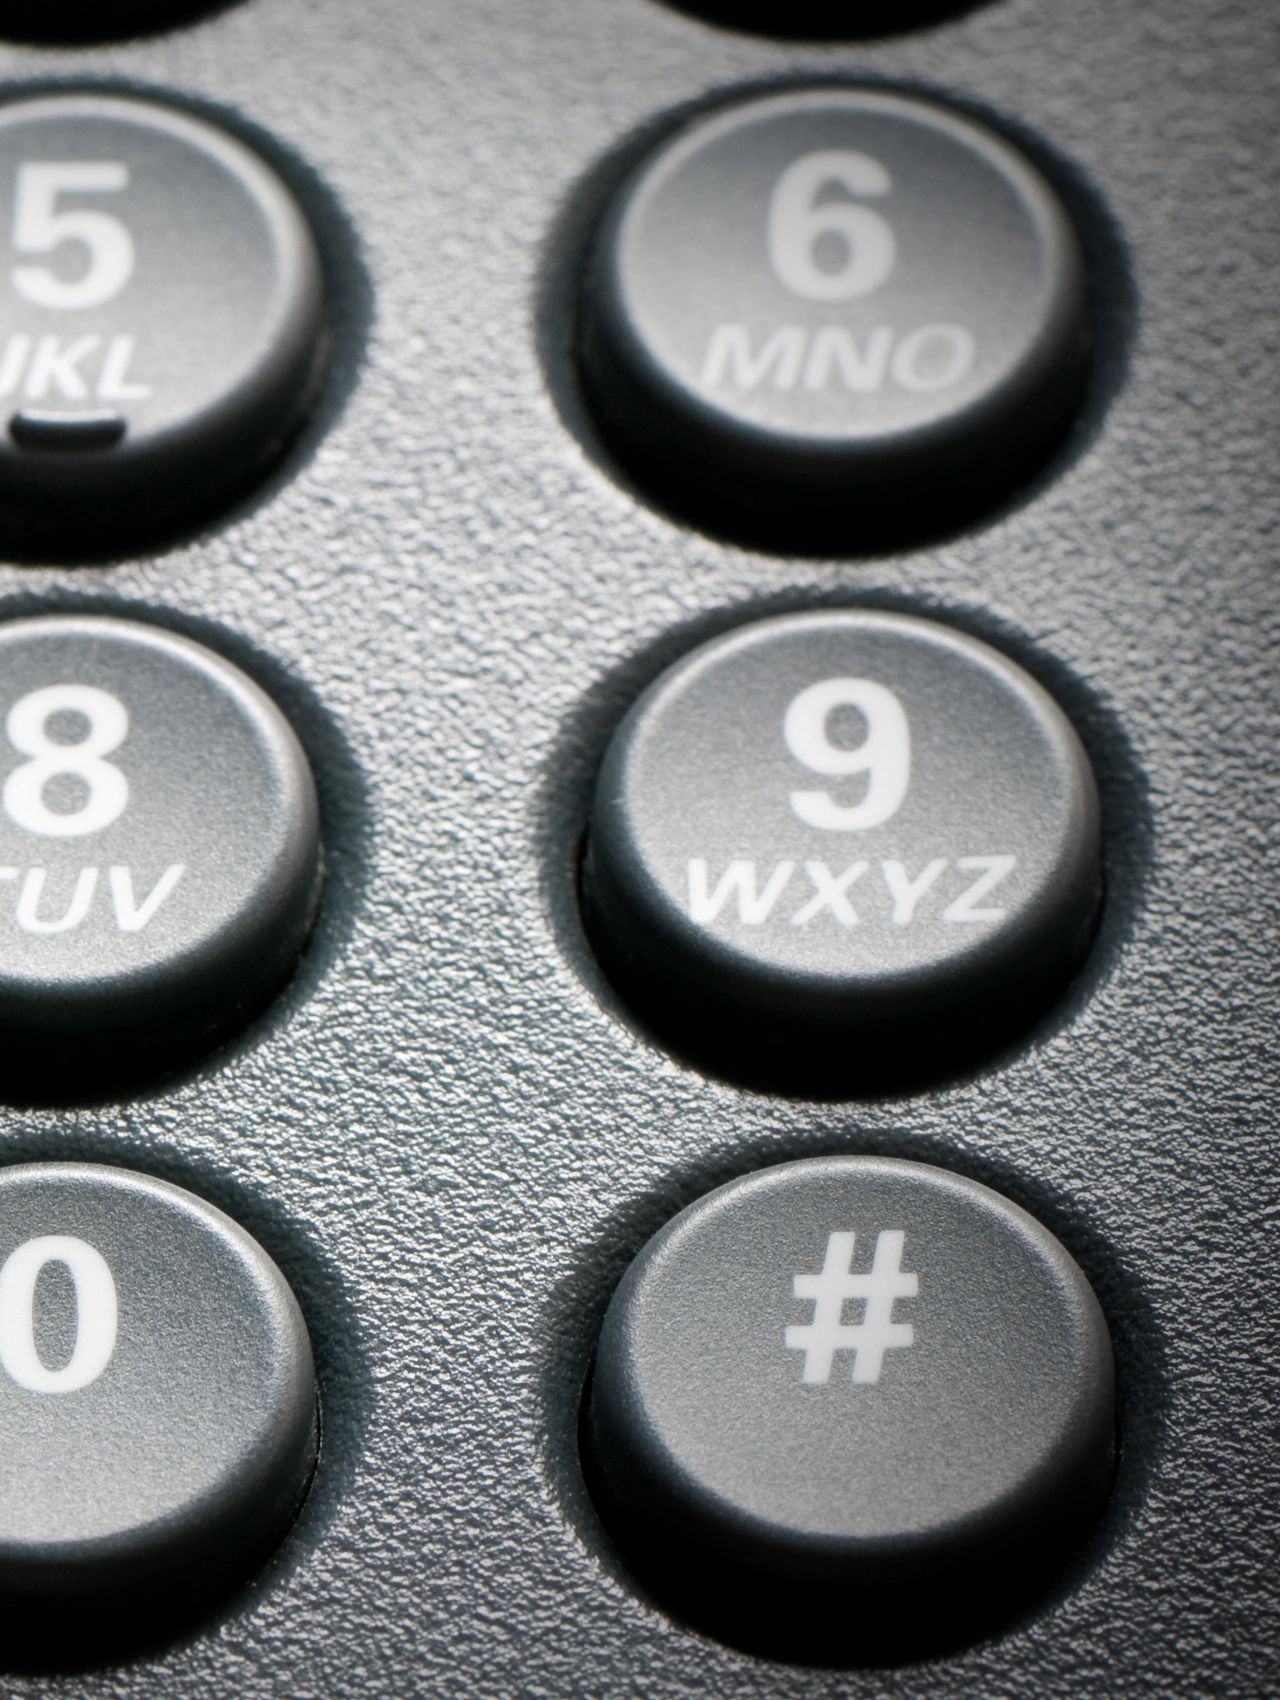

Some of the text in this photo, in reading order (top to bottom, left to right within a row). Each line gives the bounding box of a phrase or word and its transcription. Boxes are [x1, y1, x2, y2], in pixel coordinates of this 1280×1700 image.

[10, 162, 136, 309] 5
[767, 150, 896, 300] 6
[700, 323, 976, 395] MNO
[2, 684, 131, 838] 8
[782, 678, 911, 831] 9
[686, 852, 1020, 929] WXYZ
